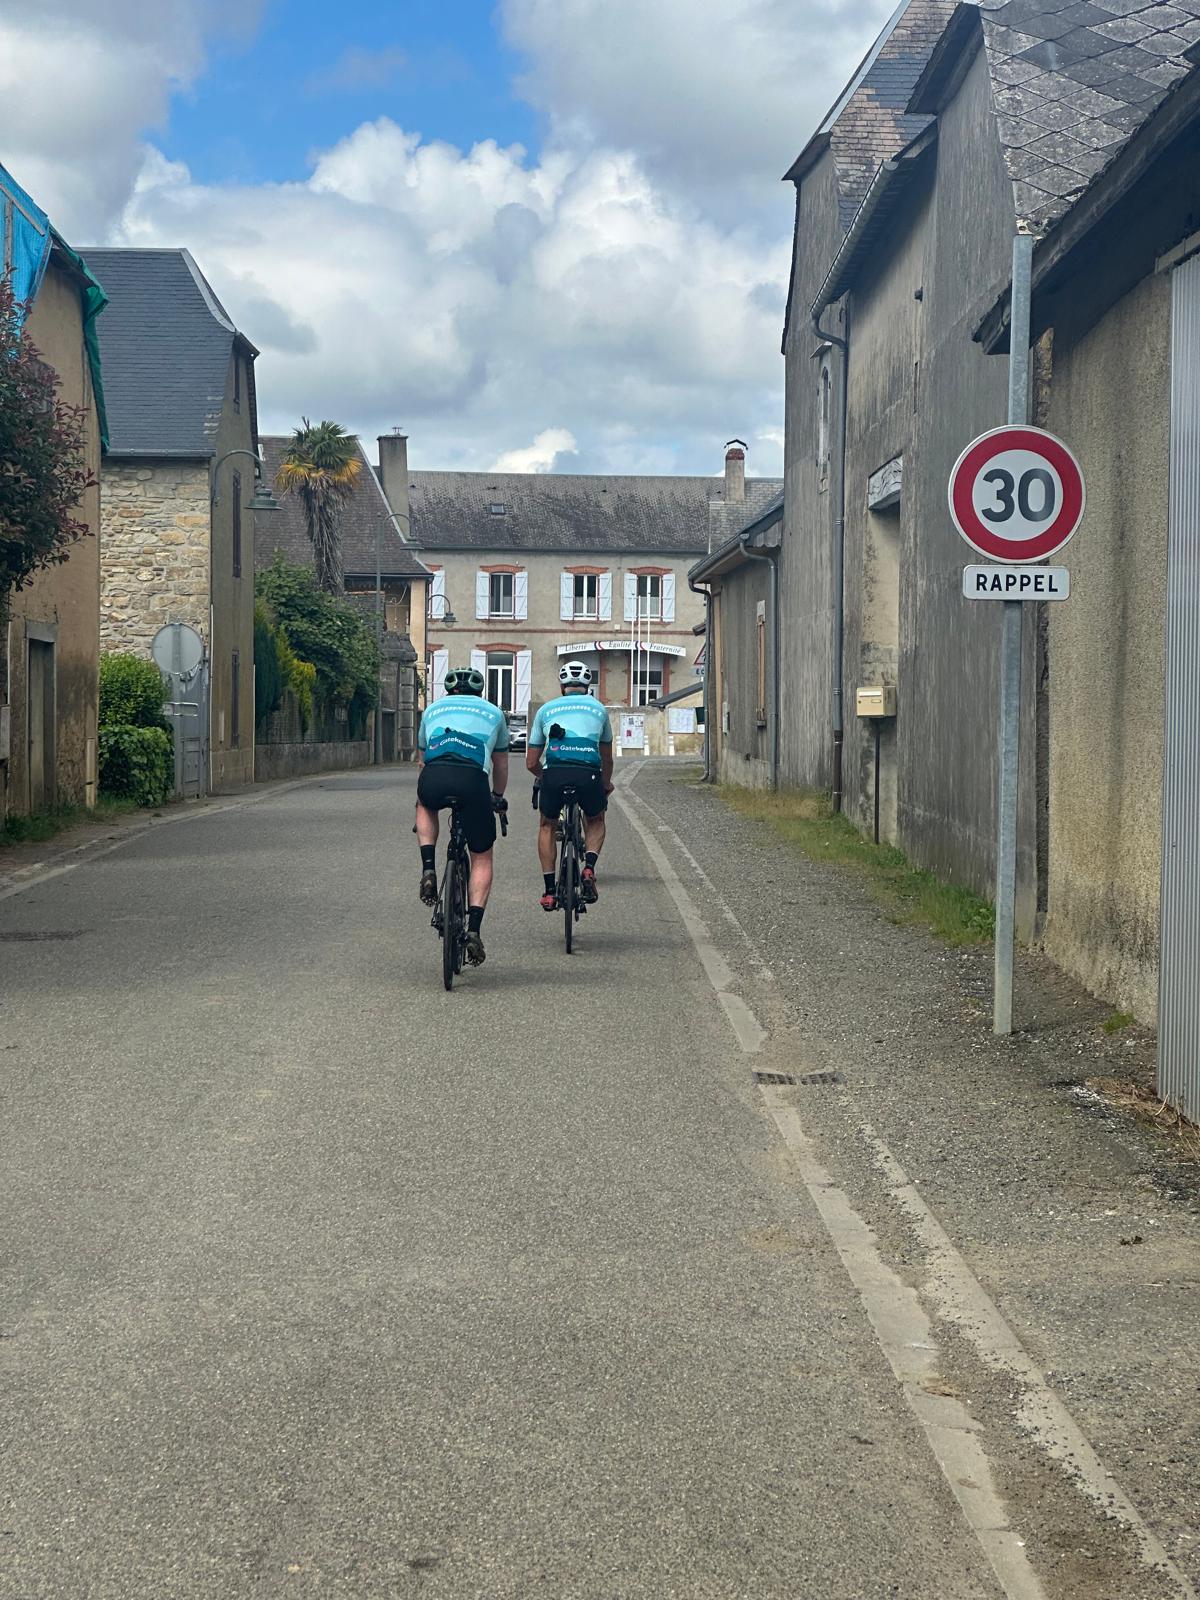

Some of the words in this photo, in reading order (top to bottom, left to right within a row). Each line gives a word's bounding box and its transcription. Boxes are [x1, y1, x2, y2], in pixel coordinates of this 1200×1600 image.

[982, 468, 1055, 522] 30
[976, 573, 1058, 592] RAPPEL
[649, 642, 681, 654] Fraternité
[440, 736, 478, 750] Gatekeeper
